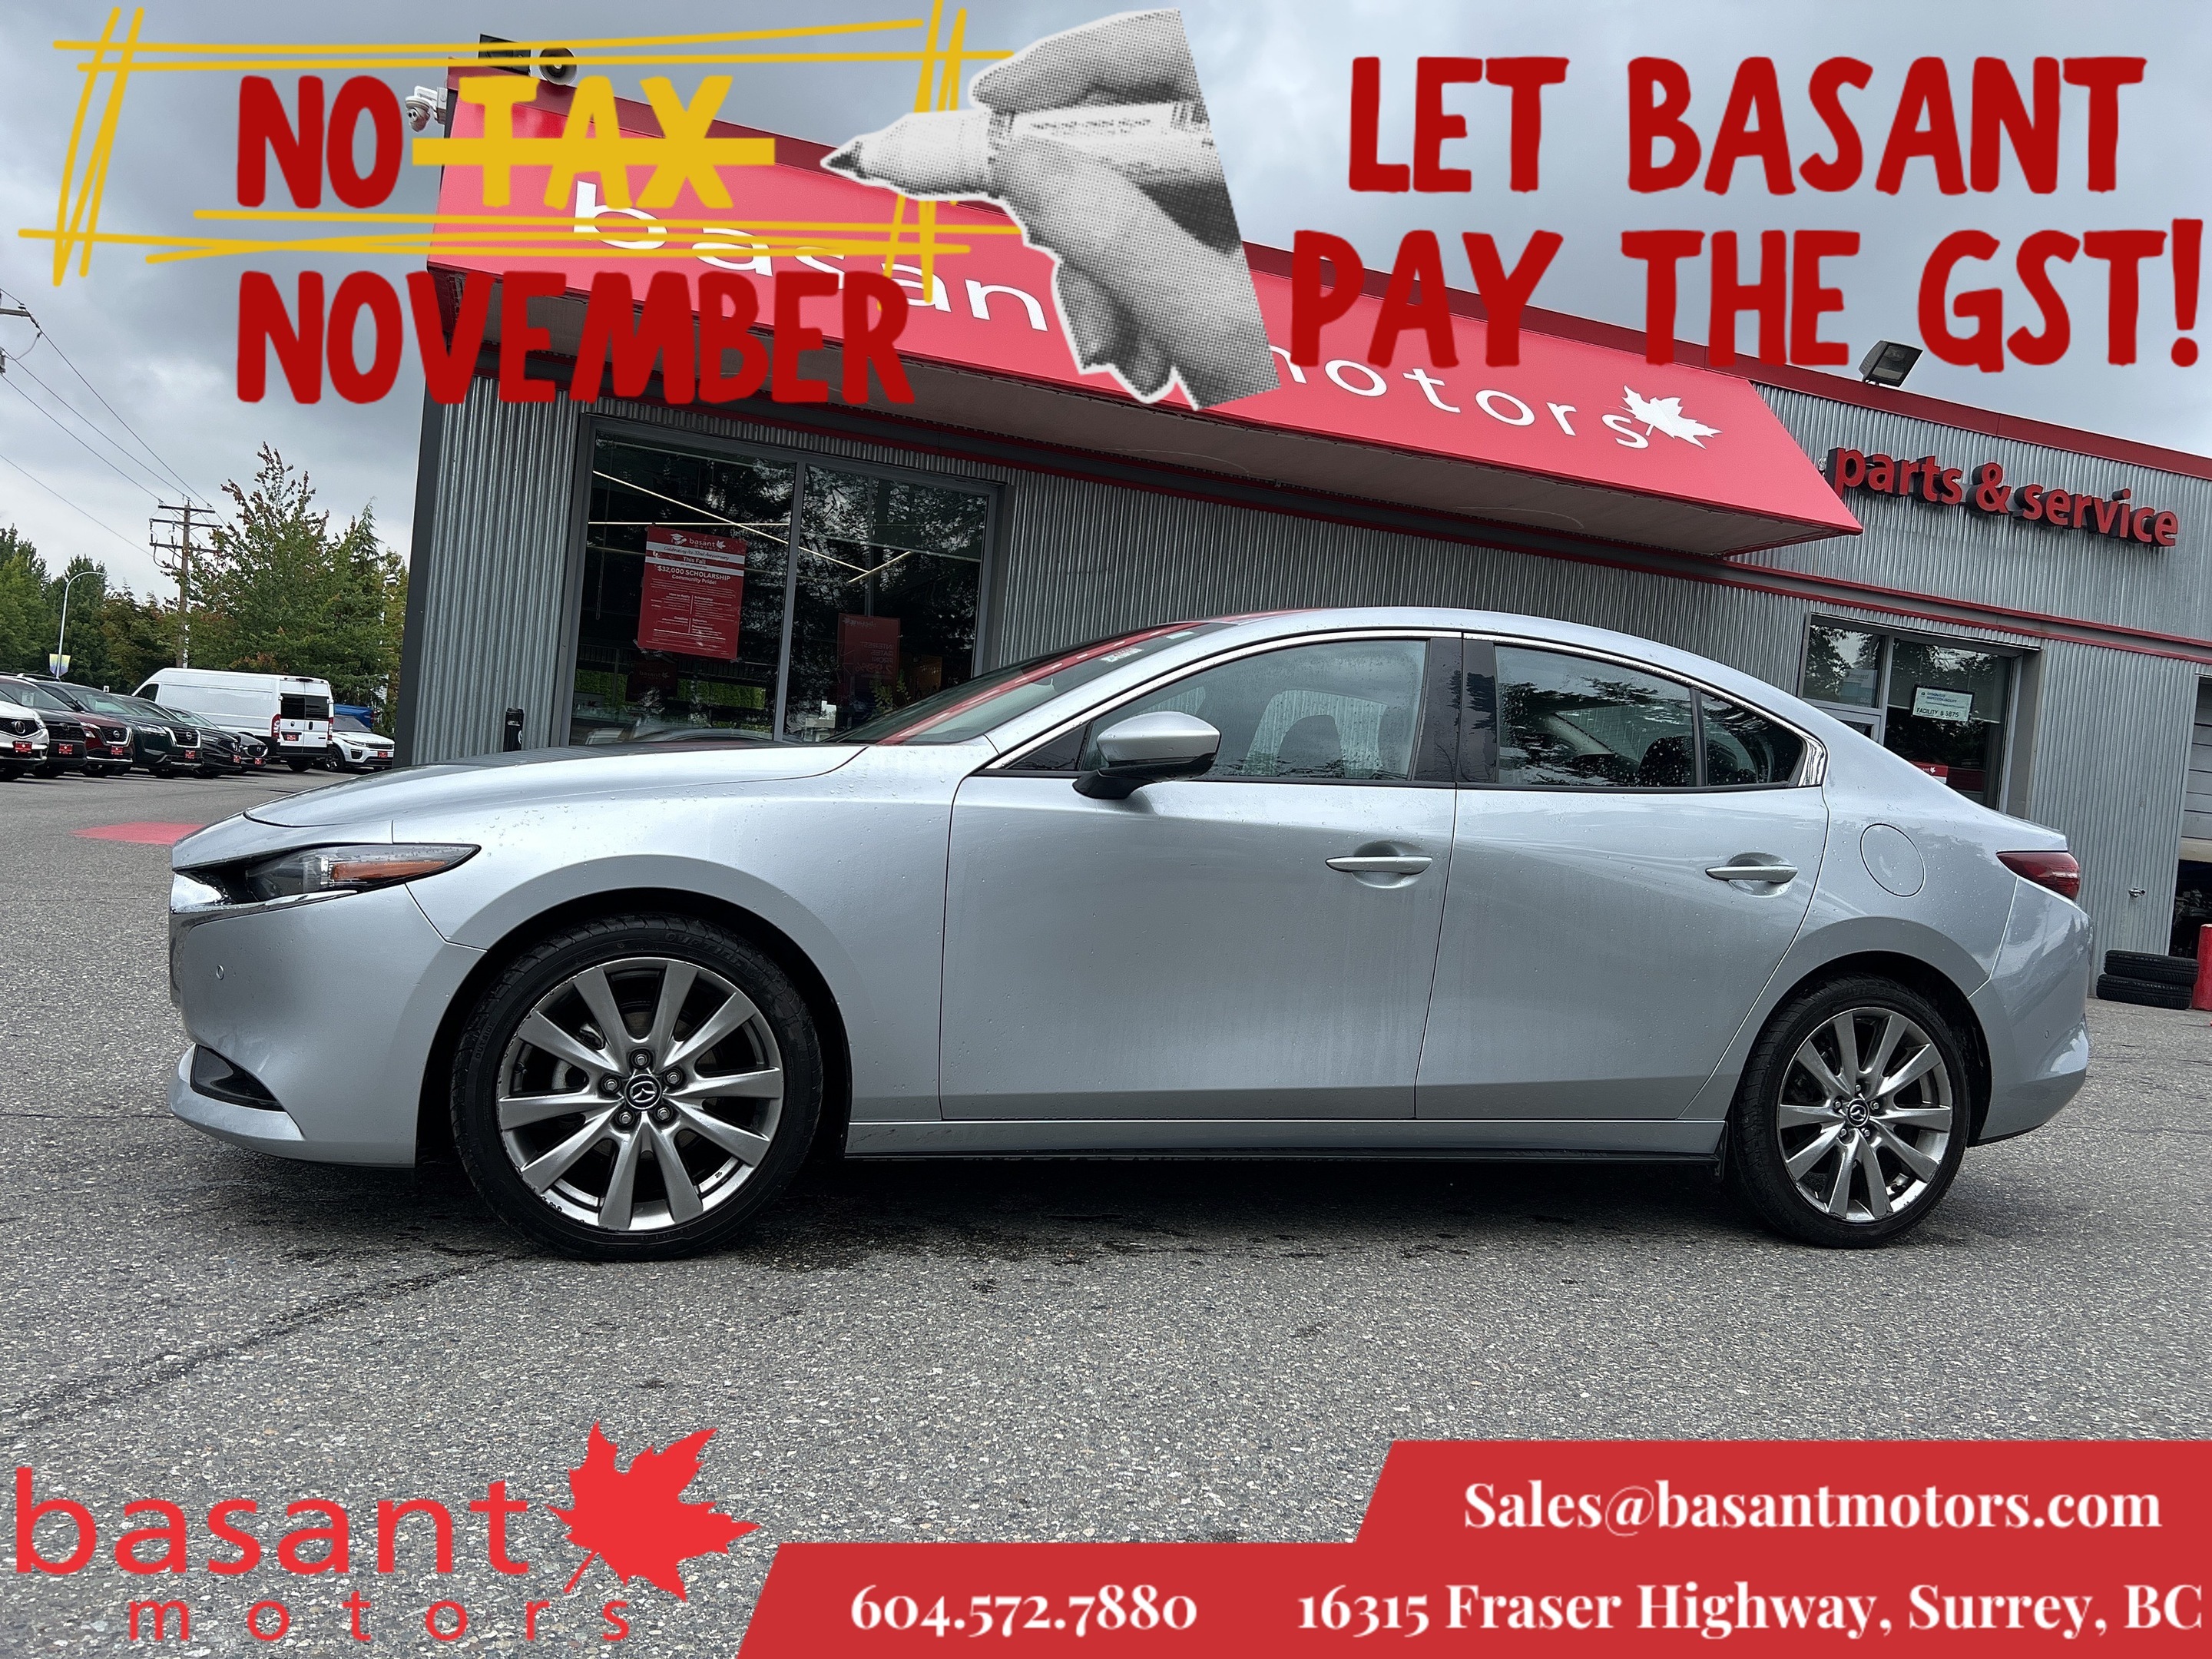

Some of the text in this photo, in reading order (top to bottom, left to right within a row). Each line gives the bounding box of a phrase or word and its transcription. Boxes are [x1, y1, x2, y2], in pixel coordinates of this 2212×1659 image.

[1829, 447, 2179, 546] parts & service
[690, 538, 715, 548] basant
[657, 565, 684, 575] $32,000
[685, 570, 731, 581] SCHOLARSHIP
[671, 574, 700, 584] Community
